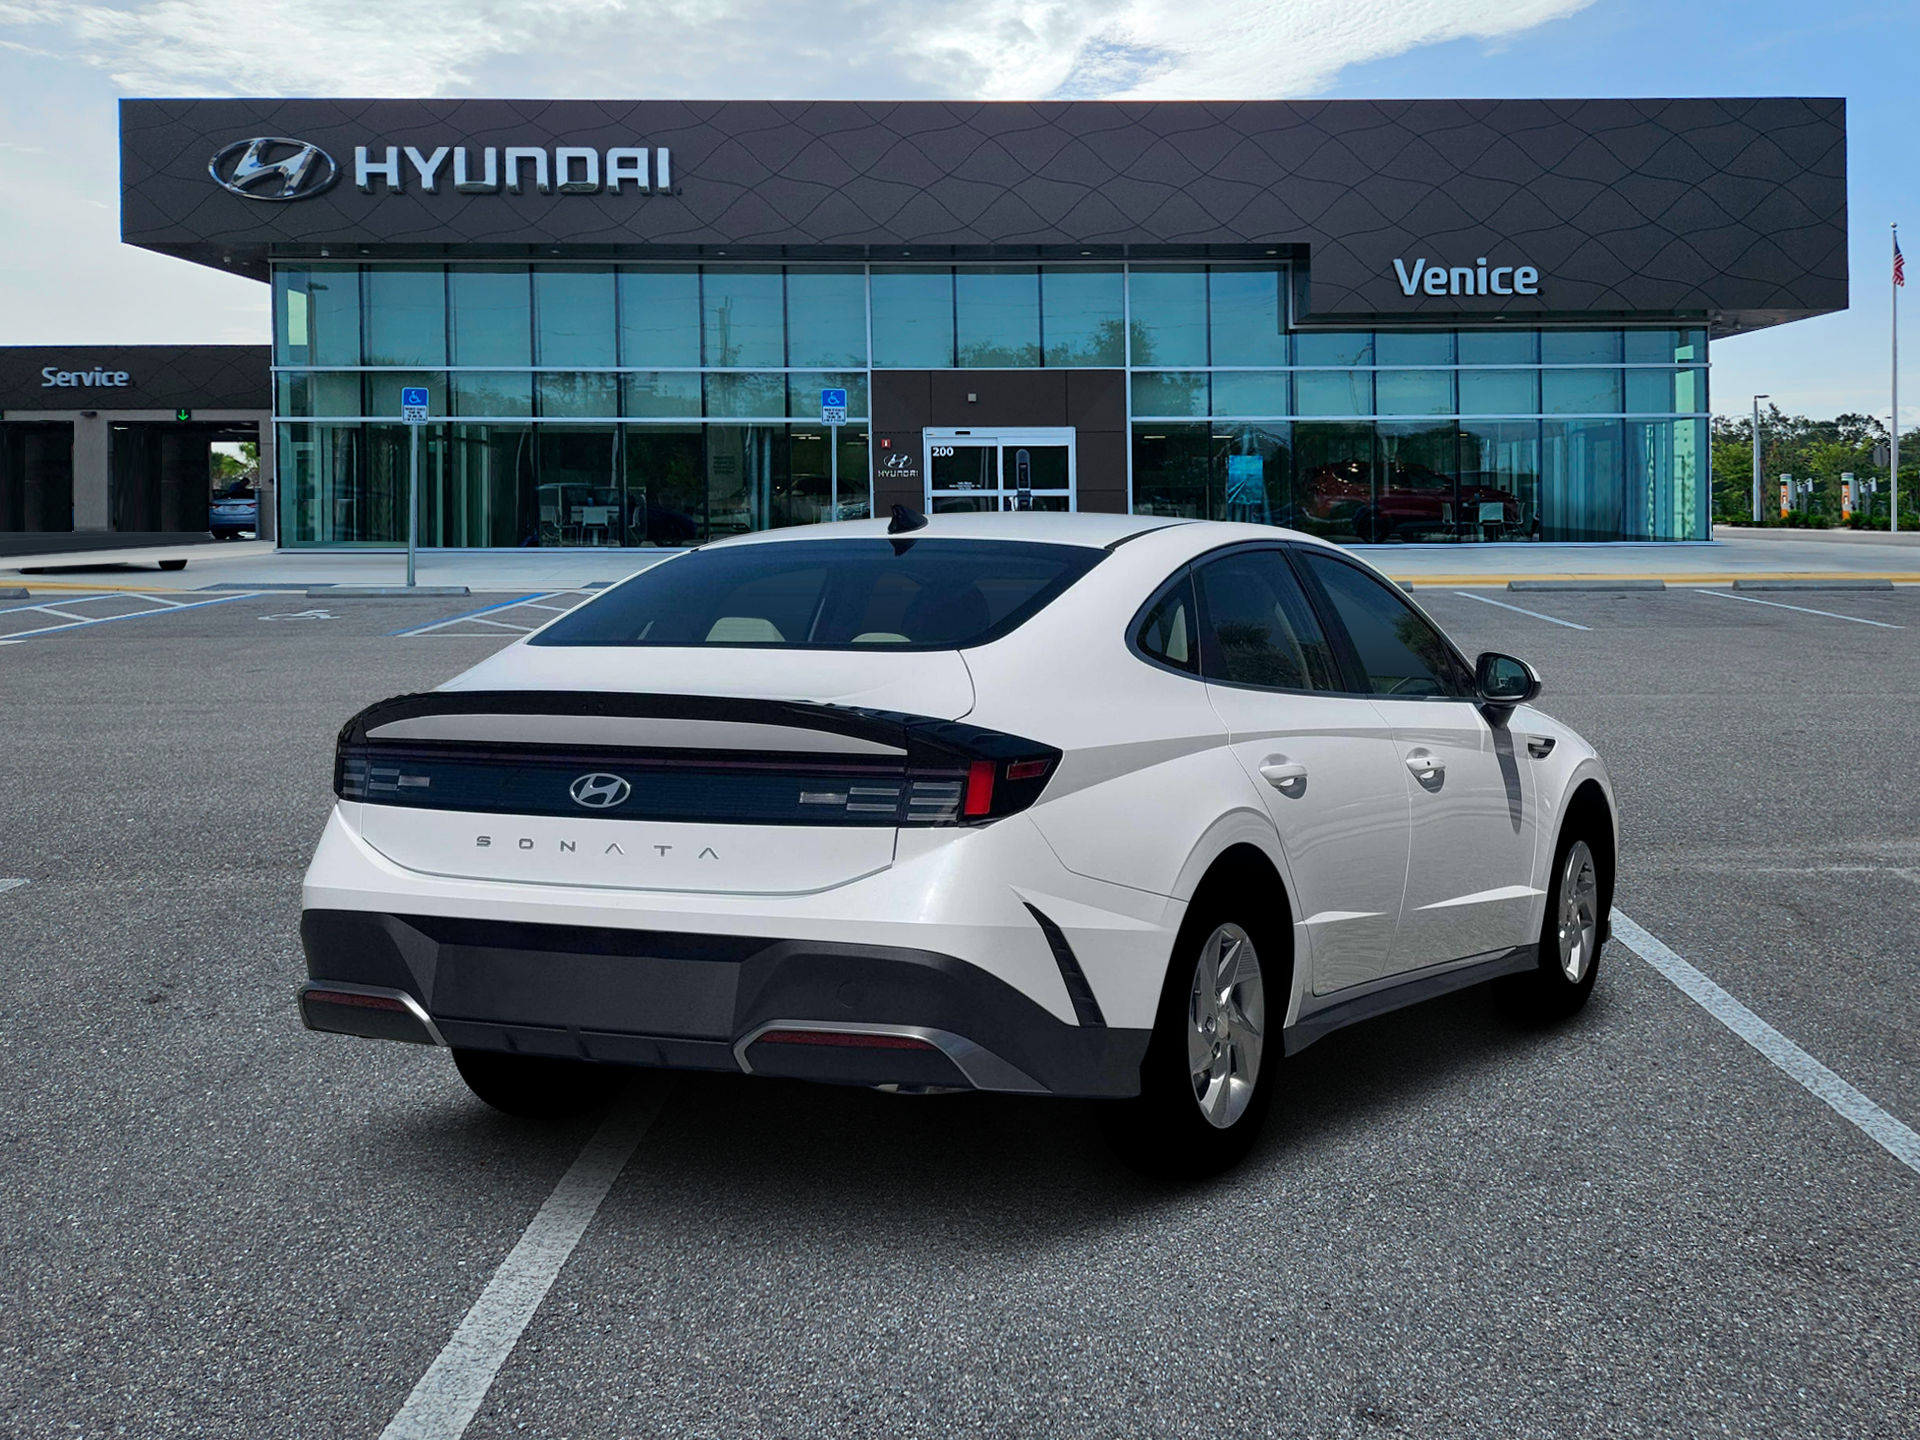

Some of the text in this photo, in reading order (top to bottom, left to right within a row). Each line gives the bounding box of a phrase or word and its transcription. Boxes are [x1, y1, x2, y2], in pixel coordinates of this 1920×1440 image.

[354, 146, 670, 195] HYUNDAI
[1393, 257, 1539, 296] Venice
[41, 366, 130, 387] Service
[932, 447, 954, 457] 200
[877, 470, 919, 478] HYUNDAI
[476, 835, 720, 860] SONATA
